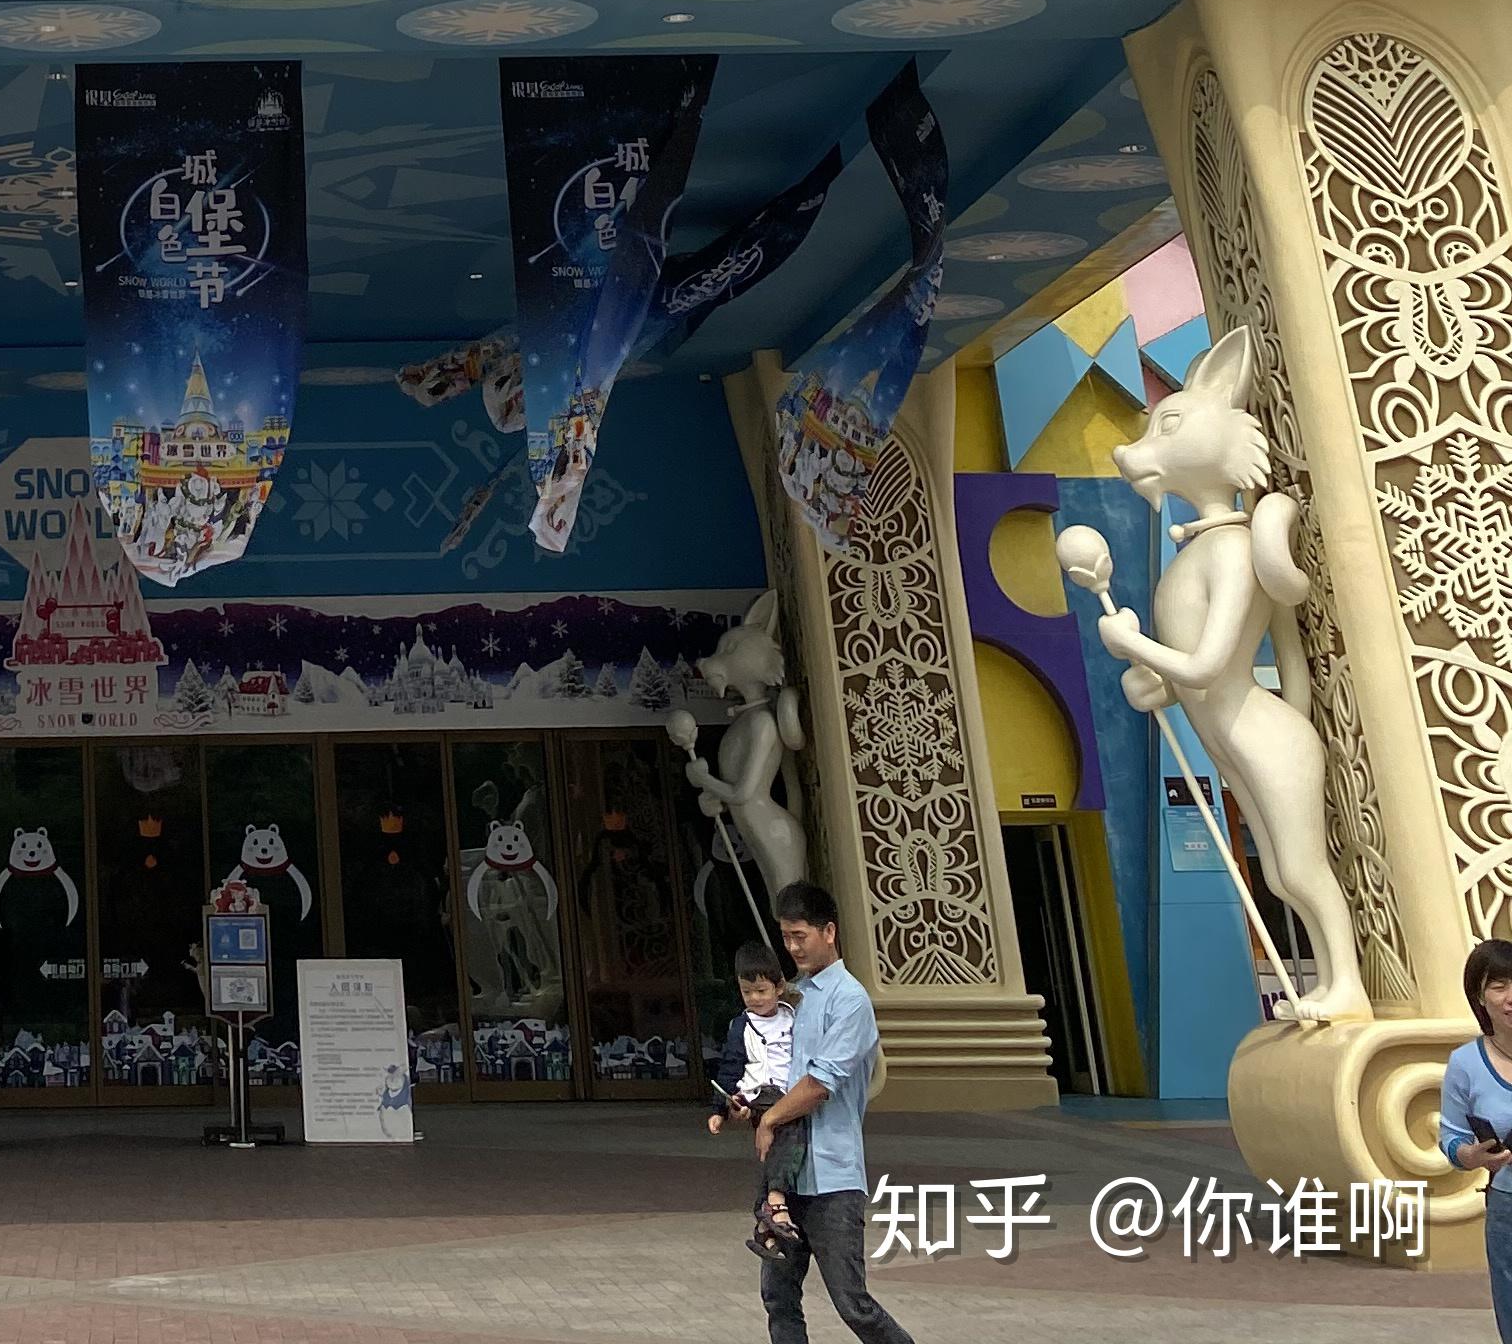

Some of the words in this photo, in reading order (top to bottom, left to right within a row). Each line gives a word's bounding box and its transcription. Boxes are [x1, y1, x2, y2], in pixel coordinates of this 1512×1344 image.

[150, 178, 188, 263] 白色
[584, 166, 617, 251] 白色
[182, 148, 247, 309] 城堡节
[118, 275, 148, 287] SNOW
[150, 275, 187, 288] WORLD
[551, 266, 584, 278] SNOW
[166, 443, 227, 458] 冰雪世界
[14, 468, 90, 499] SNO
[4, 508, 115, 541] WOL
[26, 675, 150, 706] 冰雪世界
[37, 712, 76, 729] SNOW
